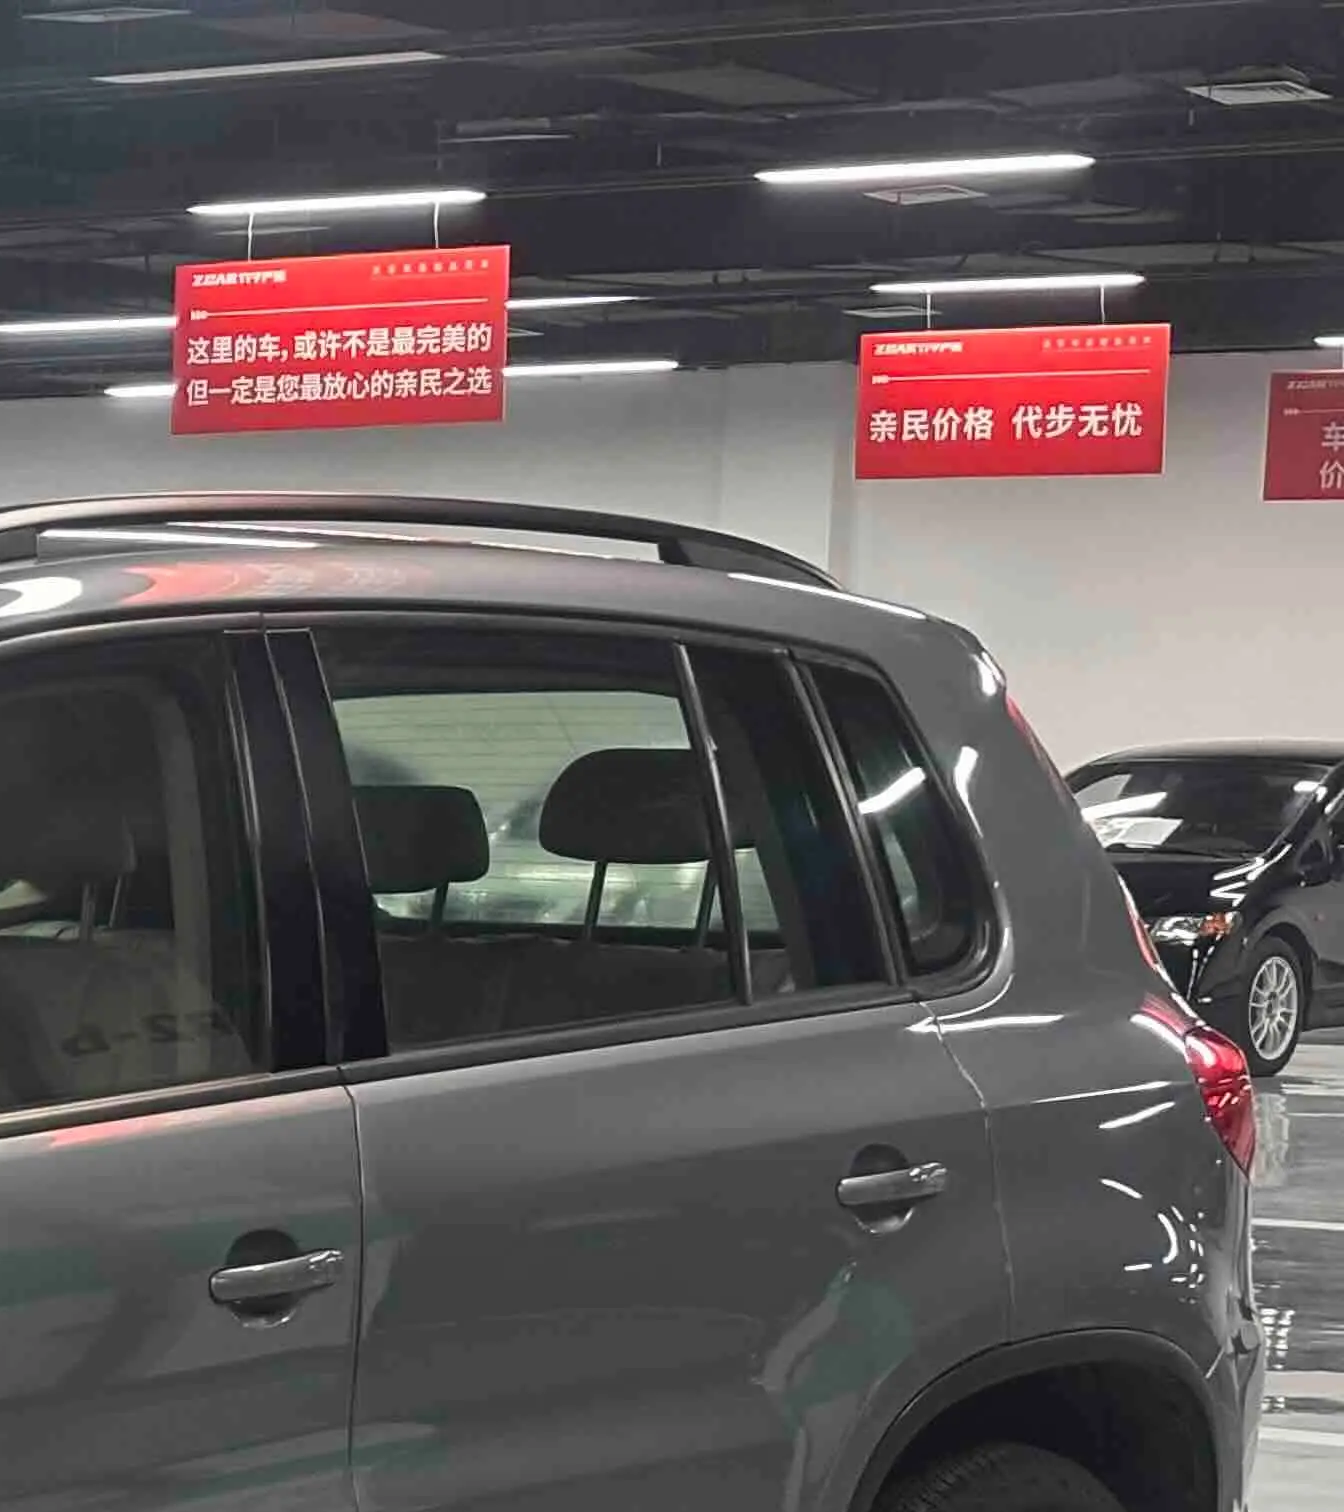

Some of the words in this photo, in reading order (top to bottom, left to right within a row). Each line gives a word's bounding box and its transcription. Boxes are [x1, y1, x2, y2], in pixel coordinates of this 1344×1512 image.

[186, 366, 492, 406] 但一定是您最放心的亲民之选
[869, 405, 994, 442] 亲民价格
[1012, 401, 1144, 441] 代步无忧
